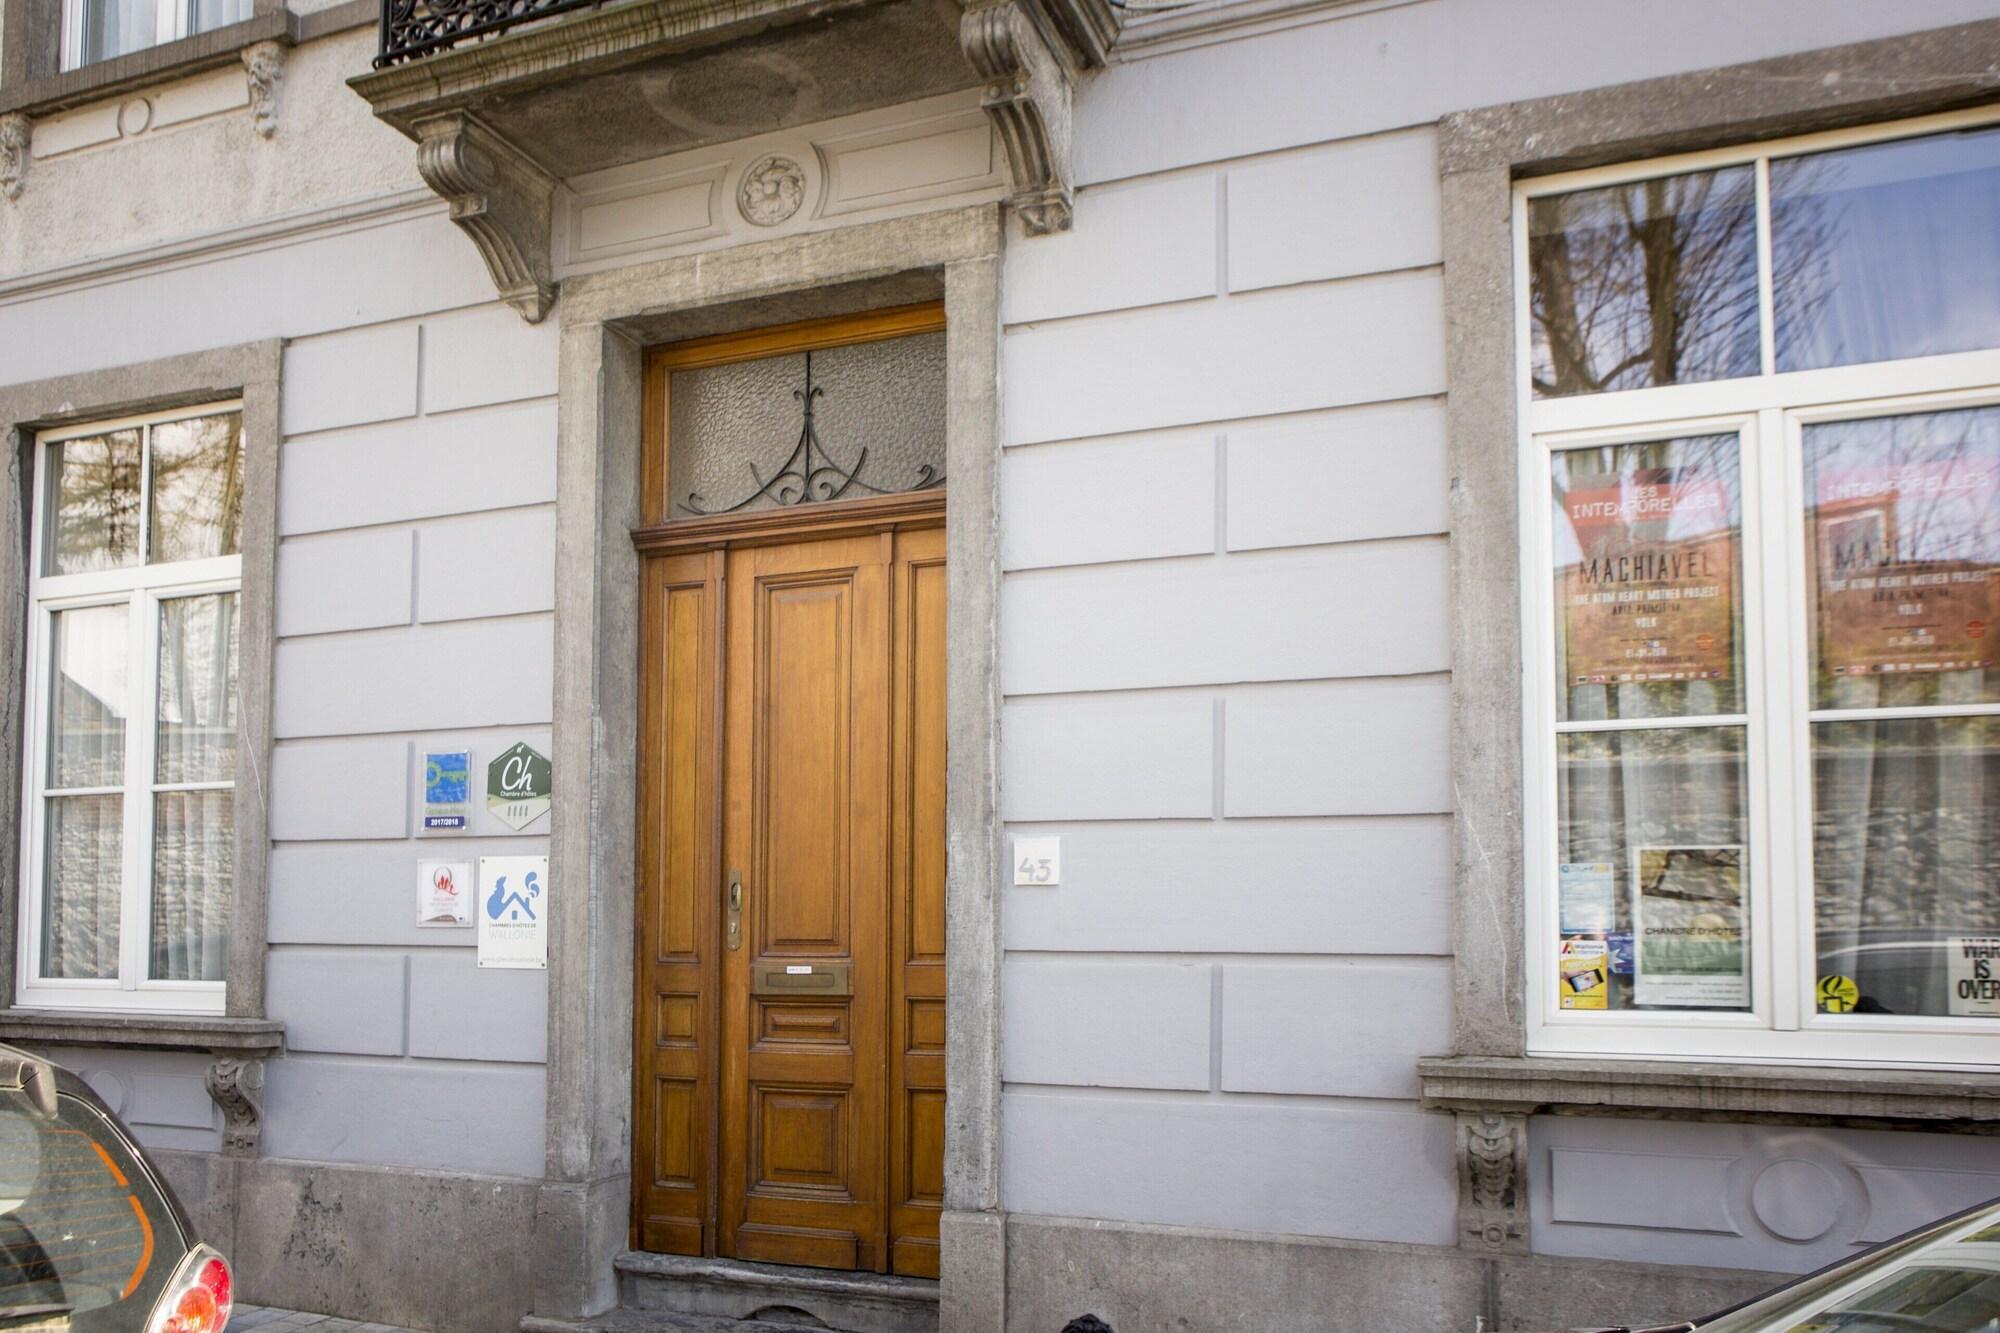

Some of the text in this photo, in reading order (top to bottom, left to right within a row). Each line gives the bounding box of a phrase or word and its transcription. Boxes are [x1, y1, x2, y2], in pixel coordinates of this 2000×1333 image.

[1579, 551, 1712, 584] MACHIAVEL
[501, 755, 532, 791] Ch
[430, 818, 459, 826] 2017/2018
[1018, 857, 1051, 882] 43
[1974, 959, 1990, 979] IS
